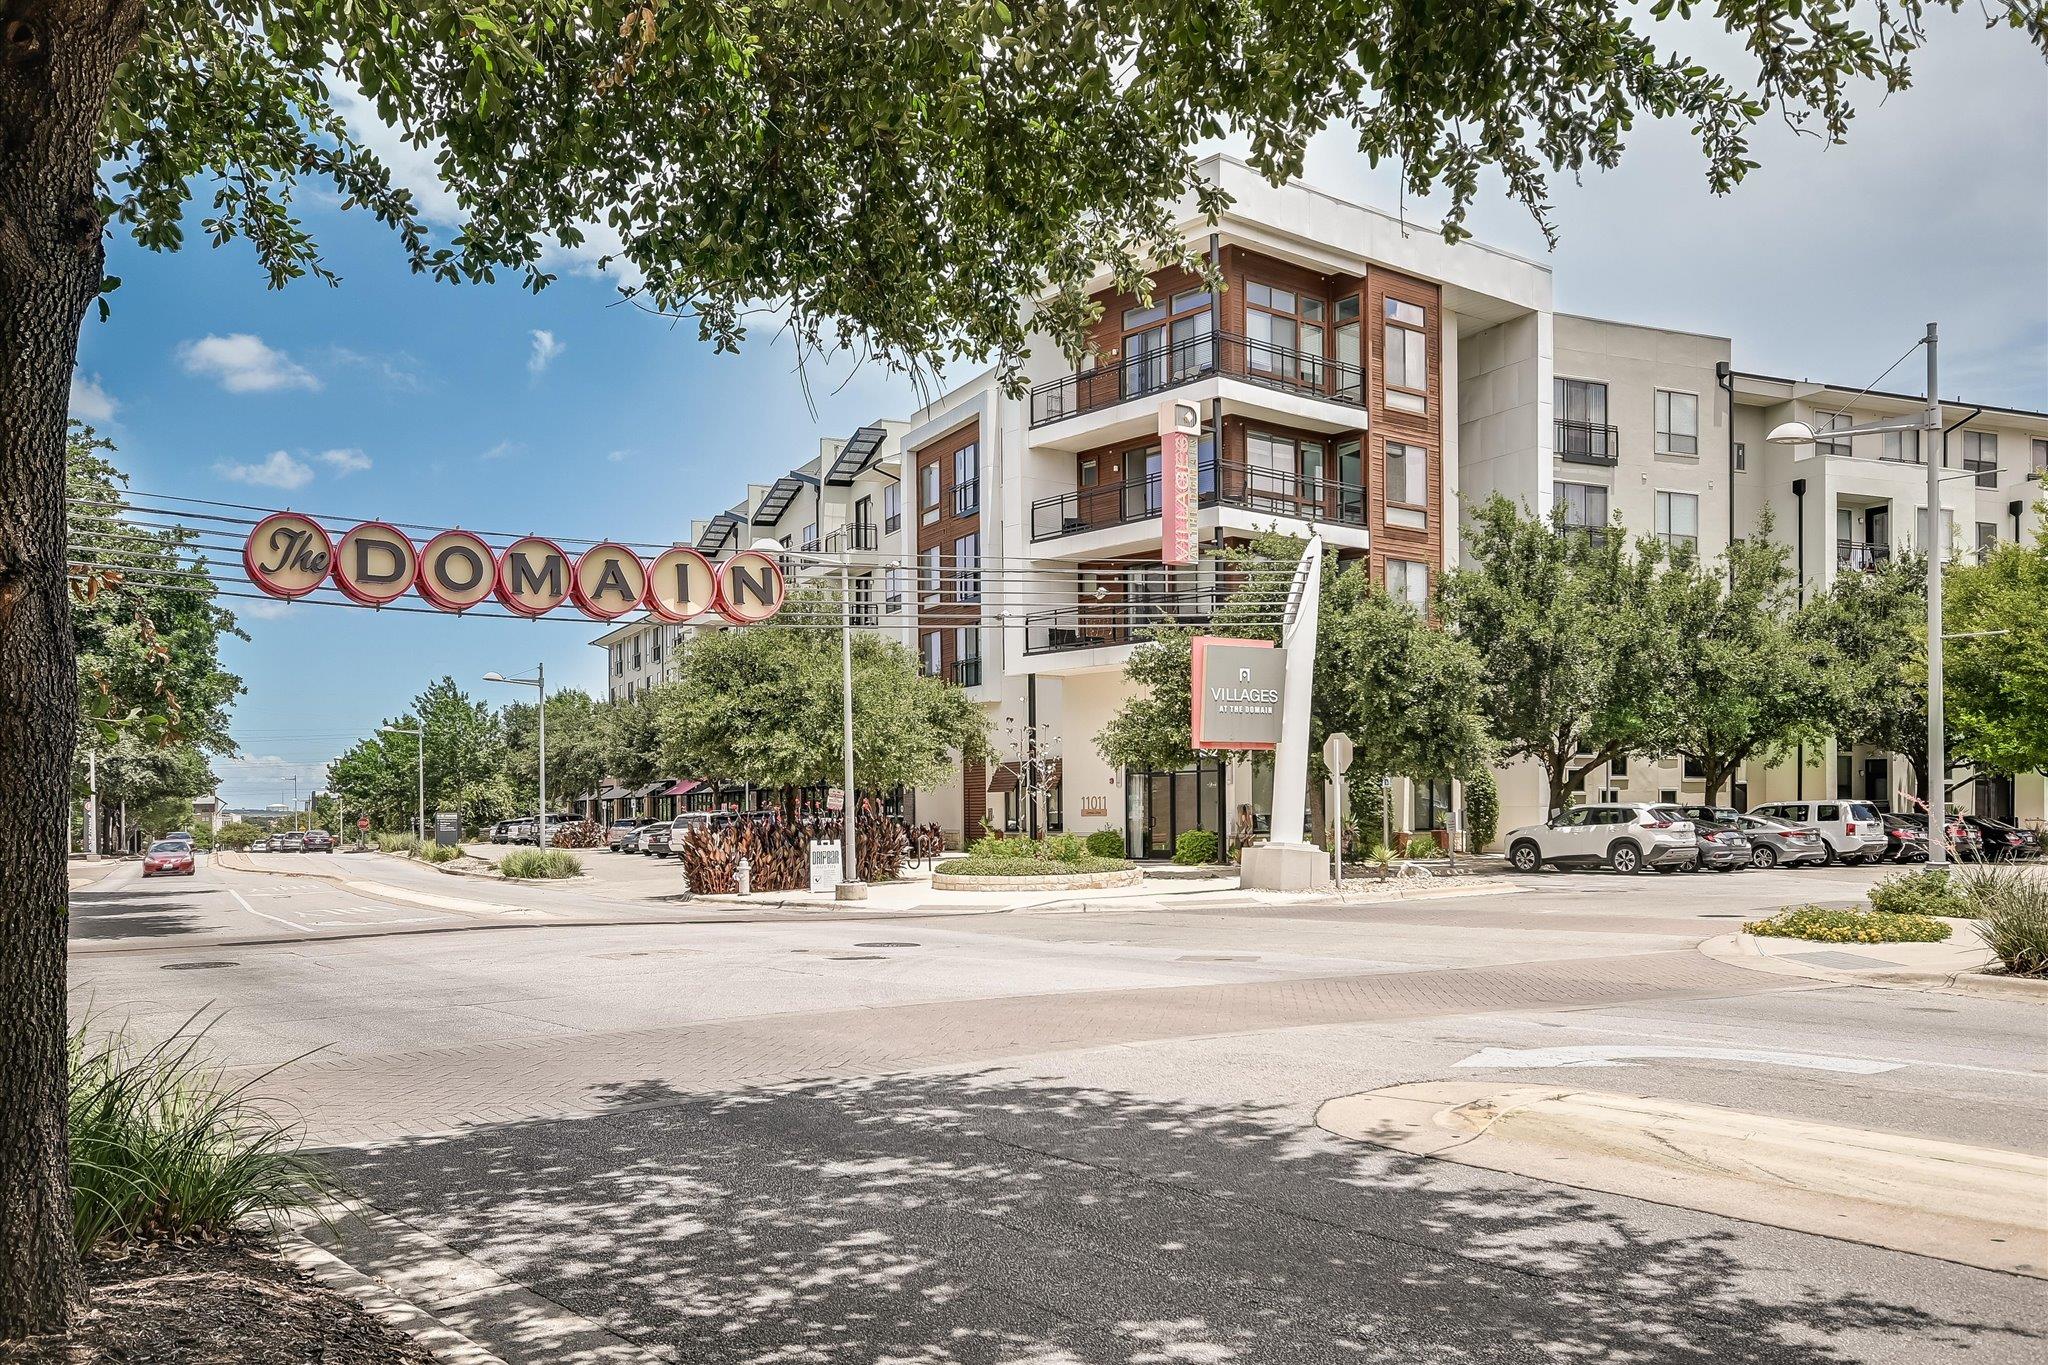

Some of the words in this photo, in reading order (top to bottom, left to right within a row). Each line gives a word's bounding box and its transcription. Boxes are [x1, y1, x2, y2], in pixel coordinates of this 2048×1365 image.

[260, 527, 330, 574] The
[354, 537, 775, 606] DOMAIN
[1211, 687, 1278, 703] VILLAGES
[1219, 705, 1228, 713] AT
[1229, 705, 1243, 714] THE
[1245, 705, 1272, 714] DOMAIN
[1081, 795, 1107, 810] 11011
